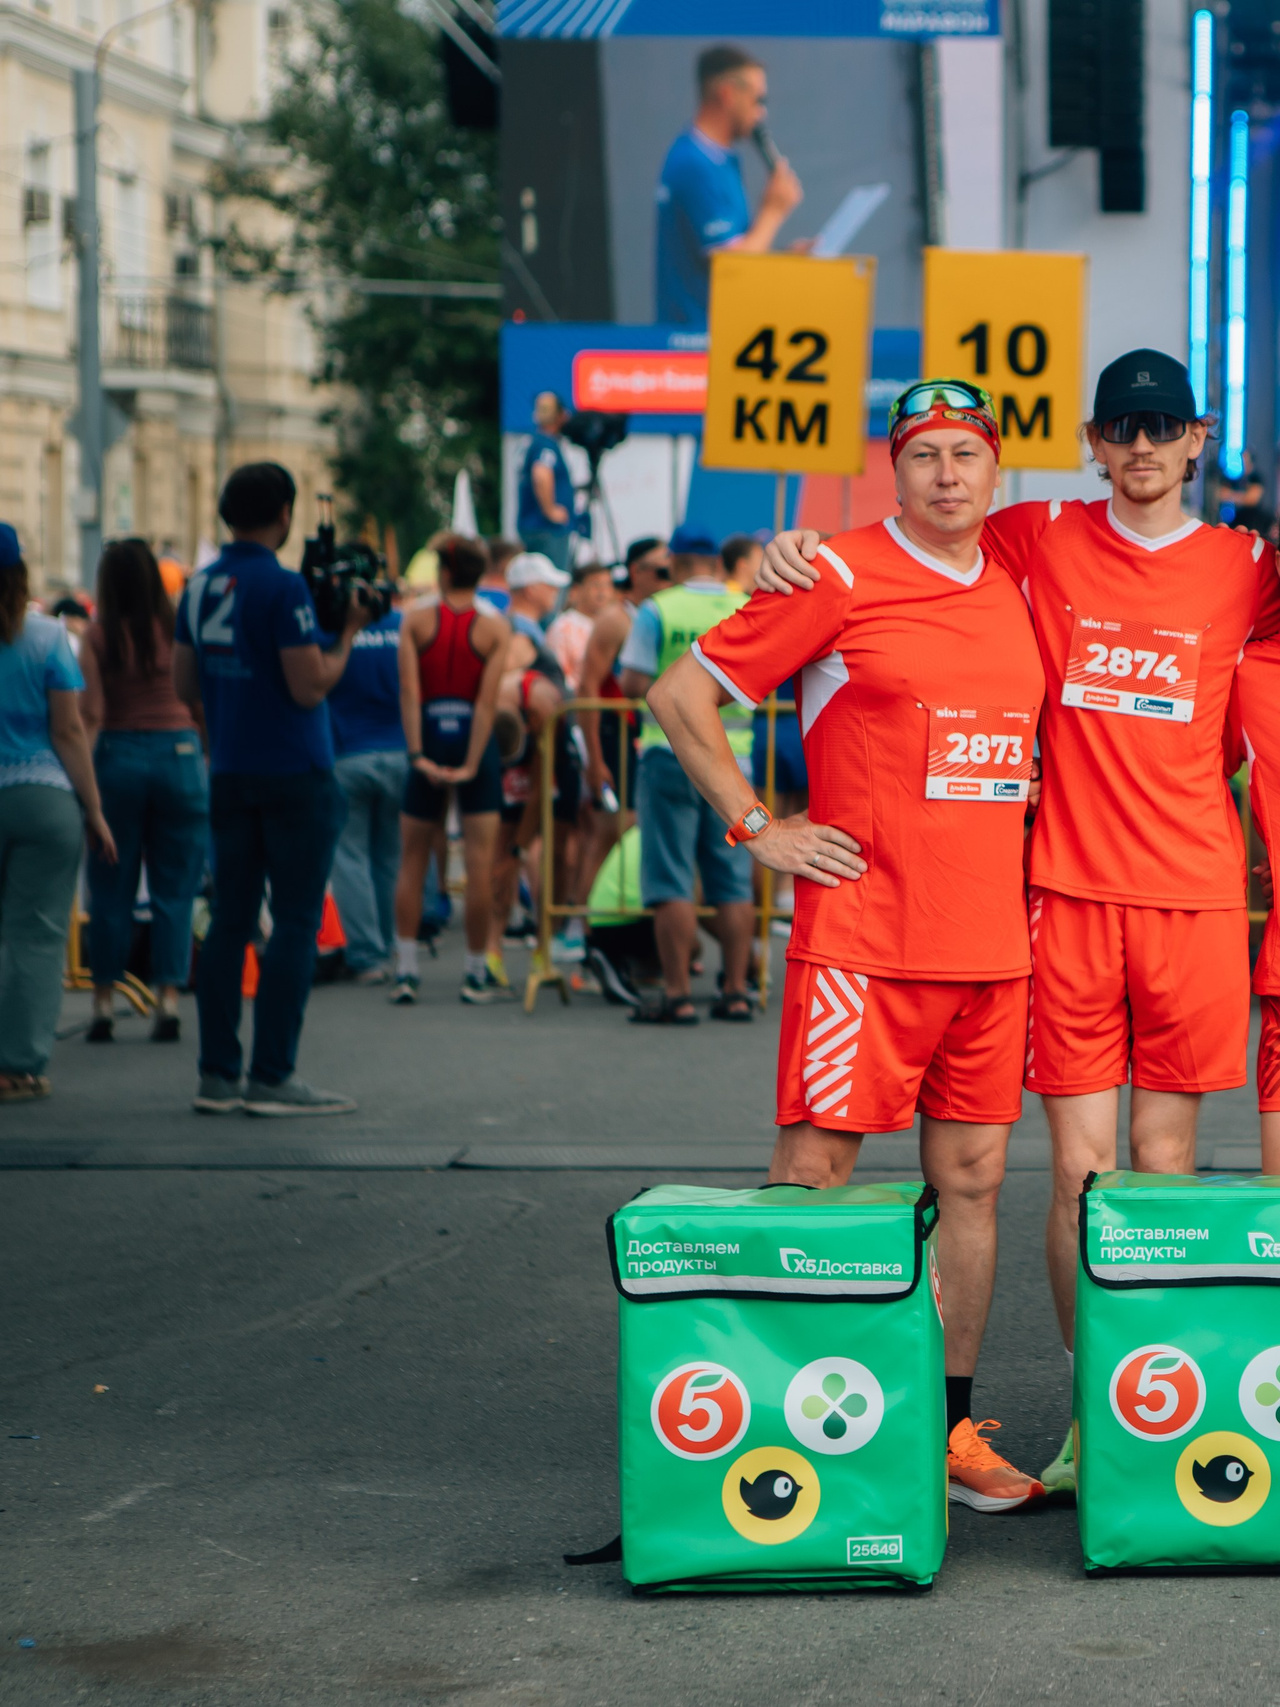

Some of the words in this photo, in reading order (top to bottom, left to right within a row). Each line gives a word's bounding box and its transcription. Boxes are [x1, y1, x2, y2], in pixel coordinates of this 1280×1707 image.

[735, 328, 829, 383] 42
[959, 322, 1049, 377] 10
[733, 396, 829, 446] КМ
[1001, 395, 1053, 440] М
[1084, 643, 1181, 684] 2874
[946, 732, 1023, 765] 2873
[626, 1240, 740, 1257] Доставляем
[1100, 1226, 1209, 1242] Доставляем
[1100, 1244, 1186, 1262] продукты
[627, 1258, 717, 1276] продукты
[676, 1370, 727, 1442] 5
[1134, 1352, 1184, 1423] 5
[852, 1543, 899, 1558] 25649
